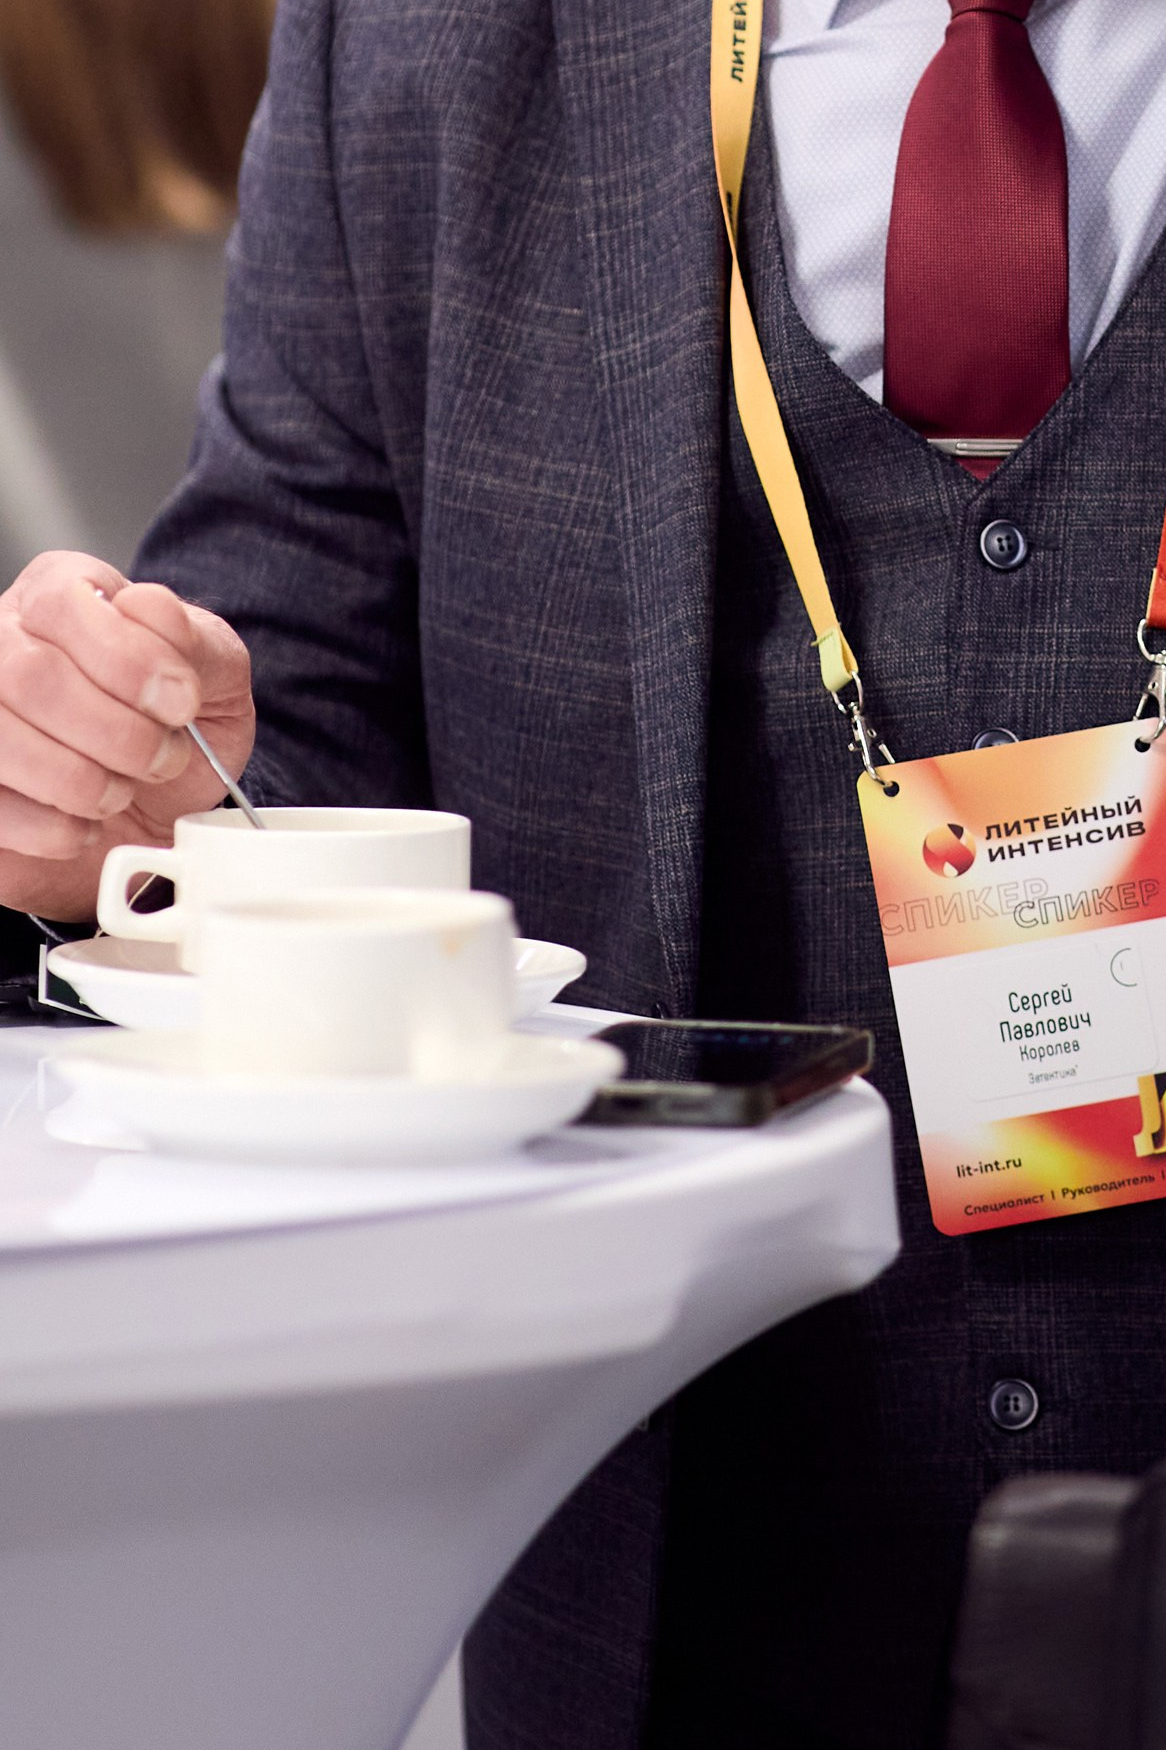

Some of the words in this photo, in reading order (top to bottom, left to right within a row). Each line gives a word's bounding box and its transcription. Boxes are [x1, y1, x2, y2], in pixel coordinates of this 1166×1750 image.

[985, 795, 1143, 841] ЛИТЕЙНЫЙ
[987, 820, 1147, 863] ИНТЕНСИВ
[879, 877, 1049, 937] СПИКЕР
[1013, 879, 1160, 929] СПИКЕР
[1008, 983, 1073, 1015] Сергей
[999, 1012, 1092, 1043] Павлович
[1019, 1039, 1081, 1062] Королев
[956, 1157, 1023, 1179] lit-int.ru
[964, 1192, 1045, 1217] Специалист
[1061, 1172, 1156, 1200] Руководитель
